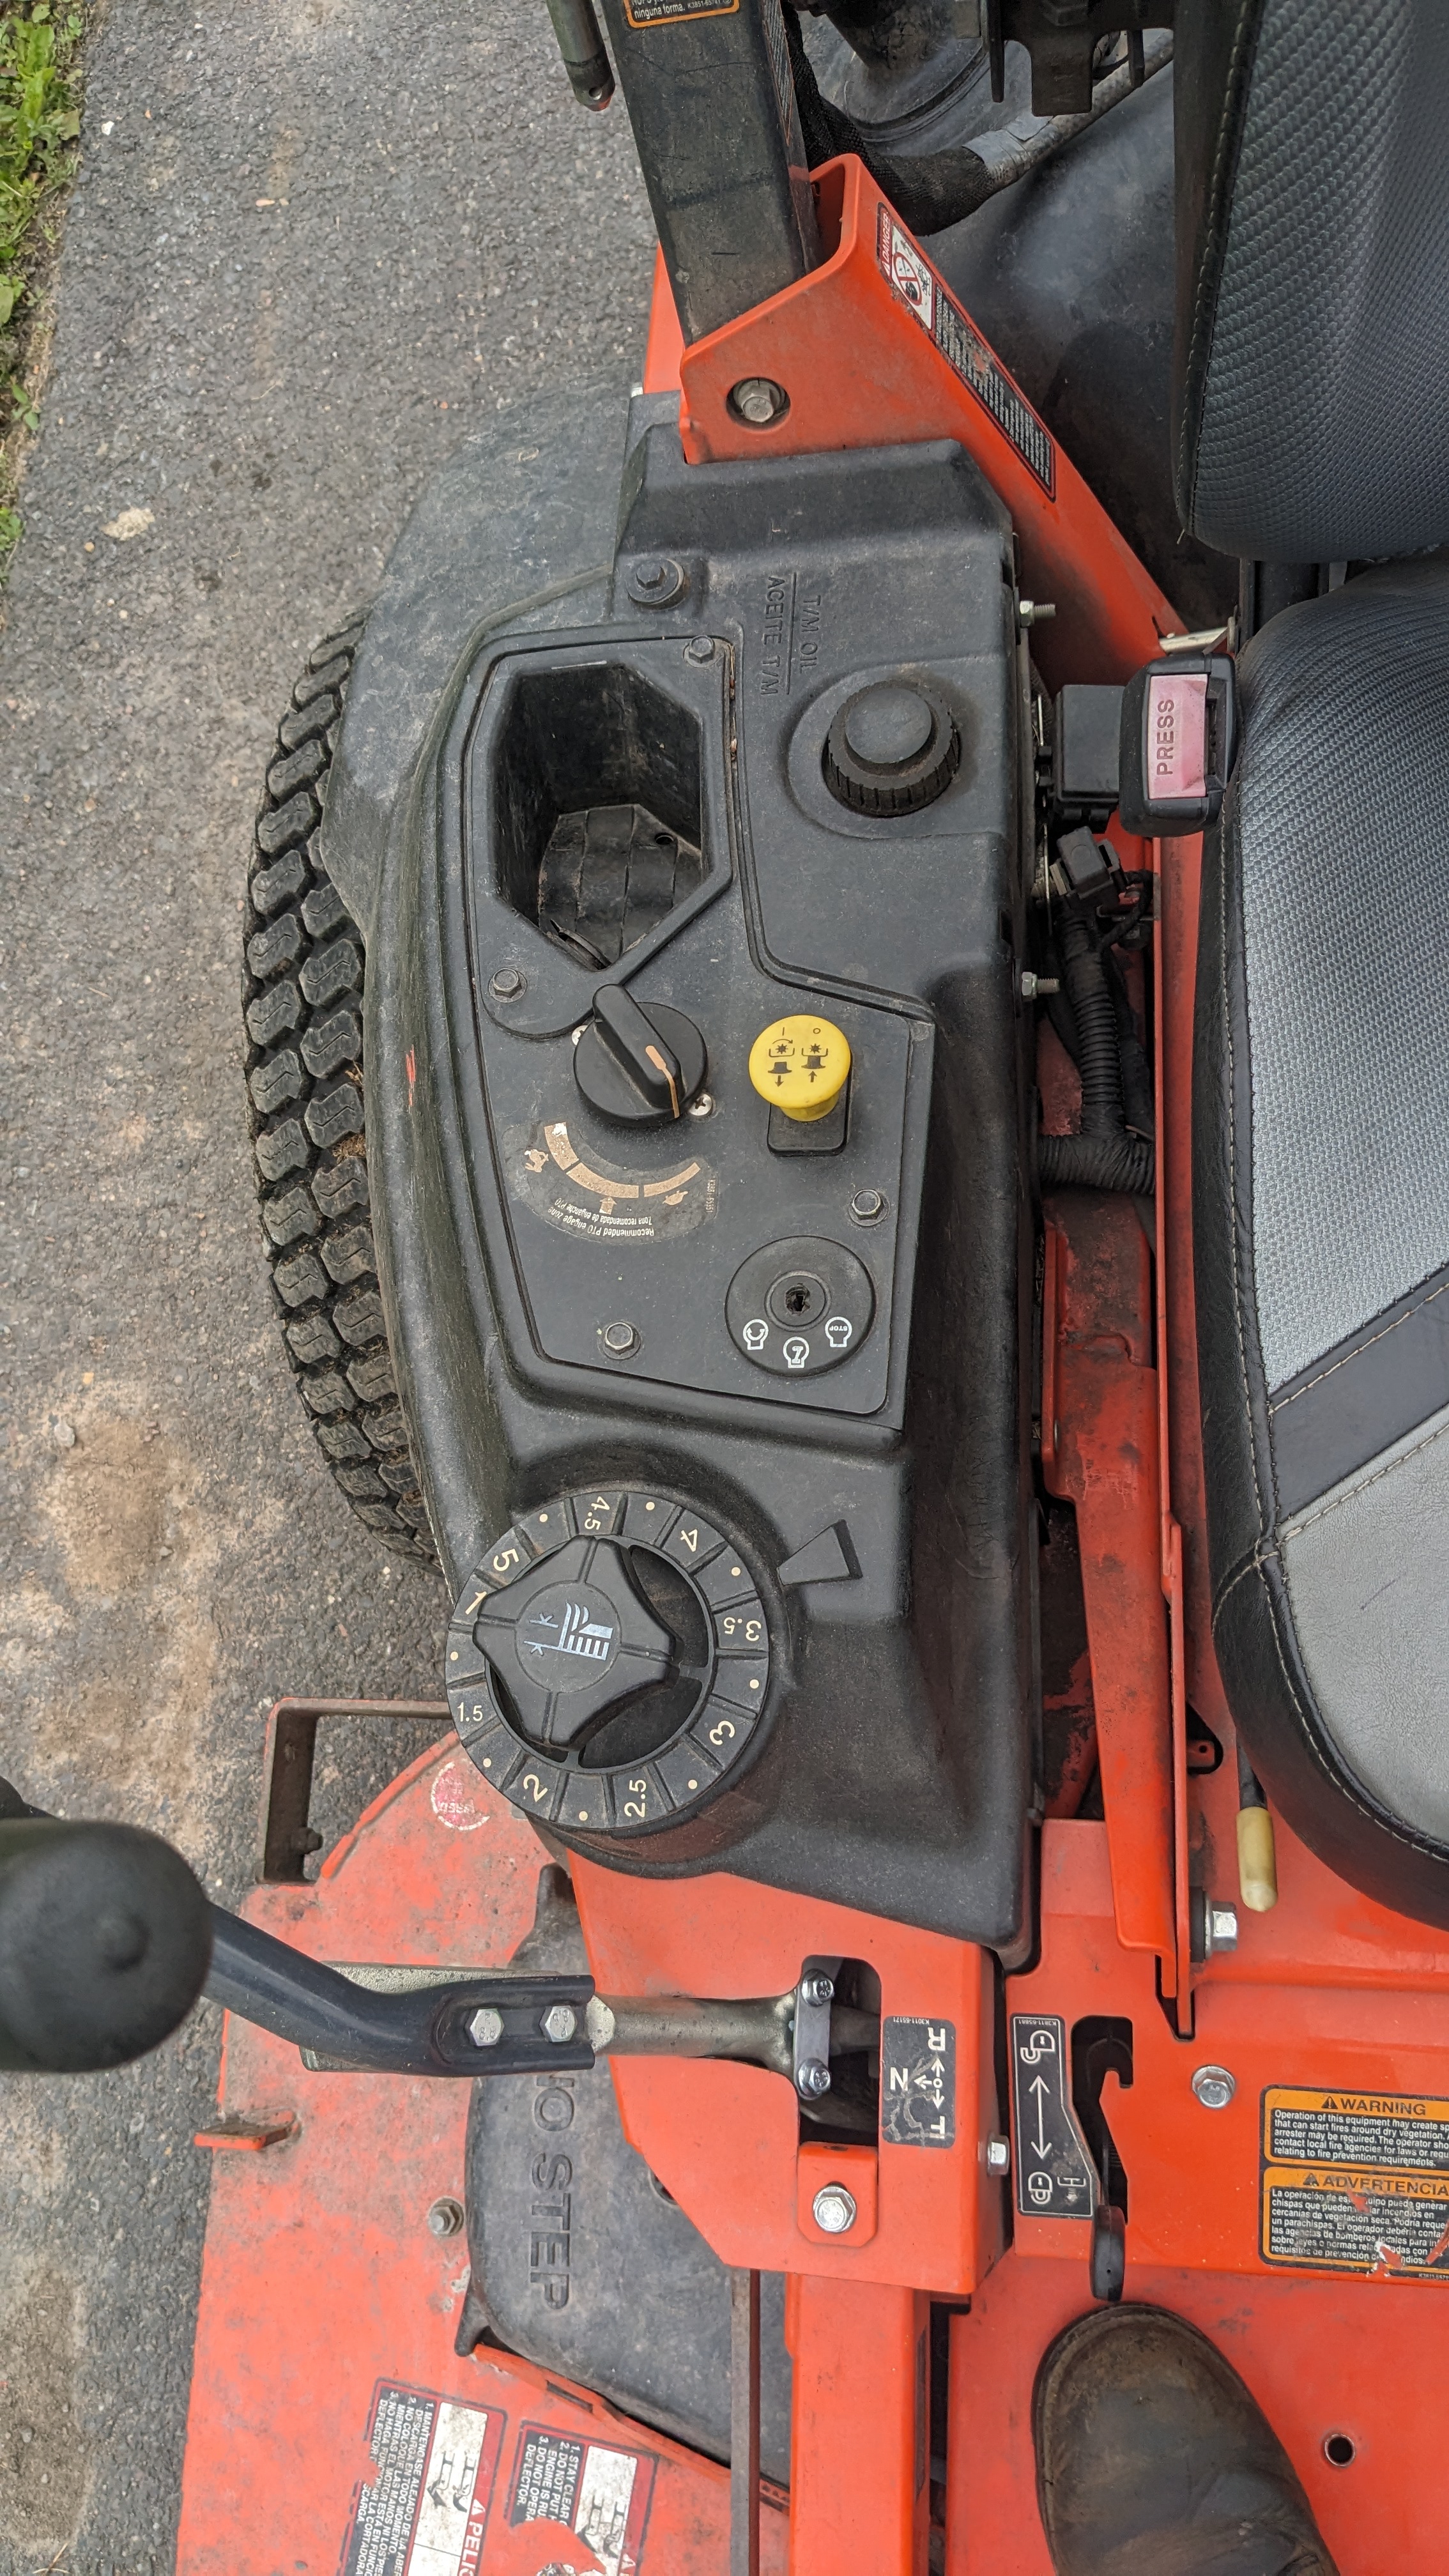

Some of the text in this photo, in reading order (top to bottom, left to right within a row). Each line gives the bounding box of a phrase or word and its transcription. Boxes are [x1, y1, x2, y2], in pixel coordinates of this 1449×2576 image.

[634, 6, 663, 20] ninguna
[663, 3, 686, 14] forma.
[882, 213, 891, 261] DANGER
[760, 576, 786, 695] ACEITE T/M
[800, 595, 821, 674] T/M OIL
[1156, 699, 1174, 776] PRESS
[548, 1206, 655, 1238] Recommended PTO engage zone
[554, 1197, 653, 1225] Zona recomendada de enganche PTO
[584, 1496, 610, 1531] 4.5
[680, 1528, 698, 1552] 4
[493, 1548, 519, 1572] 5
[723, 1617, 760, 1642] 3.5
[457, 1701, 484, 1722] 1.5
[709, 1720, 735, 1746] 3
[523, 1773, 548, 1803] 2
[624, 1779, 647, 1818] 2.5
[927, 2027, 946, 2051] R
[890, 2067, 908, 2091] N
[1340, 2098, 1426, 2116] WARNING
[929, 2115, 946, 2139] F
[1275, 2109, 1315, 2121] Operation
[1328, 2114, 1344, 2123] this
[1345, 2116, 1390, 2127] equipment
[1392, 2119, 1410, 2131] may
[1411, 2122, 1438, 2130] create
[1275, 2119, 1291, 2128] that
[1292, 2121, 1308, 2129] can
[1310, 2122, 1329, 2131] start
[1331, 2123, 1349, 2133] fires
[1351, 2126, 1381, 2135] around
[1383, 2127, 1397, 2138] dry
[1399, 2130, 1445, 2140] vegetation.
[1274, 2138, 1305, 2147] contact
[1307, 2139, 1327, 2149] local
[1329, 2141, 1342, 2150] fire
[1344, 2143, 1382, 2153] agencies
[1384, 2145, 1396, 2154] for
[1397, 2146, 1417, 2156] laws
[1275, 2129, 1307, 2138] arrester
[1308, 2132, 1326, 2142] may
[1327, 2132, 1338, 2140] be
[1340, 2135, 1377, 2145] required.
[1378, 2136, 1394, 2145] The
[1396, 2138, 1432, 2148] operator
[1274, 2146, 1305, 2158] relating
[1317, 2149, 1331, 2158] fire
[1332, 2152, 1377, 2161] prevention
[1379, 2156, 1437, 2167] requirements.
[1322, 2175, 1449, 2196] ADVERTENCIA
[1271, 2198, 1303, 2209] chispas
[1322, 2203, 1353, 2212] pueden
[1272, 2188, 1283, 2197] La
[1326, 2194, 1337, 2202] de
[1415, 2202, 1448, 2212] generar
[1284, 2219, 1335, 2230] parachispas.
[1312, 2211, 1323, 2220] de
[530, 2152, 572, 2309] STEP
[1271, 2225, 1284, 2234] las
[1323, 2230, 1334, 2239] de
[1409, 2238, 1427, 2247] para
[1271, 2235, 1295, 2244] sobre
[1412, 2247, 1428, 2256] con
[387, 2400, 396, 2416] NO
[405, 2406, 414, 2421] NO
[426, 2402, 433, 2411] 1.
[371, 2398, 387, 2455] DEFLECTOR
[381, 2417, 393, 2444] HAGA
[390, 2404, 405, 2452] MIENTRAS
[395, 2422, 411, 2468] COLOQUE
[539, 2435, 548, 2445] 3.
[560, 2441, 569, 2451] 2.
[571, 2444, 580, 2453] 1.
[387, 2453, 395, 2465] EL
[536, 2446, 546, 2463] DO
[557, 2452, 568, 2469] DO
[392, 2469, 401, 2488] LAS
[516, 2443, 536, 2506] DEFLECTOR.
[532, 2464, 543, 2486] NOT
[542, 2449, 557, 2488] ENGINE
[565, 2455, 579, 2483] STAY
[380, 2466, 393, 2501] MOTOR
[388, 2409, 423, 2556] DESCARGA EN TODO MOMENTO.
[553, 2469, 565, 2492] NOT
[404, 2476, 419, 2521] ALEJADO
[540, 2489, 549, 2500] IS
[549, 2492, 561, 2514] PUT
[559, 2484, 574, 2518] CLEAR
[368, 2501, 376, 2514] LA
[385, 2490, 397, 2524] MANOS
[372, 2528, 381, 2542] EN
[383, 2526, 390, 2536] NI
[402, 2522, 410, 2536] DE
[356, 2515, 373, 2575] CORTADORA
[378, 2537, 388, 2557] LOS
[399, 2537, 407, 2550] LA
